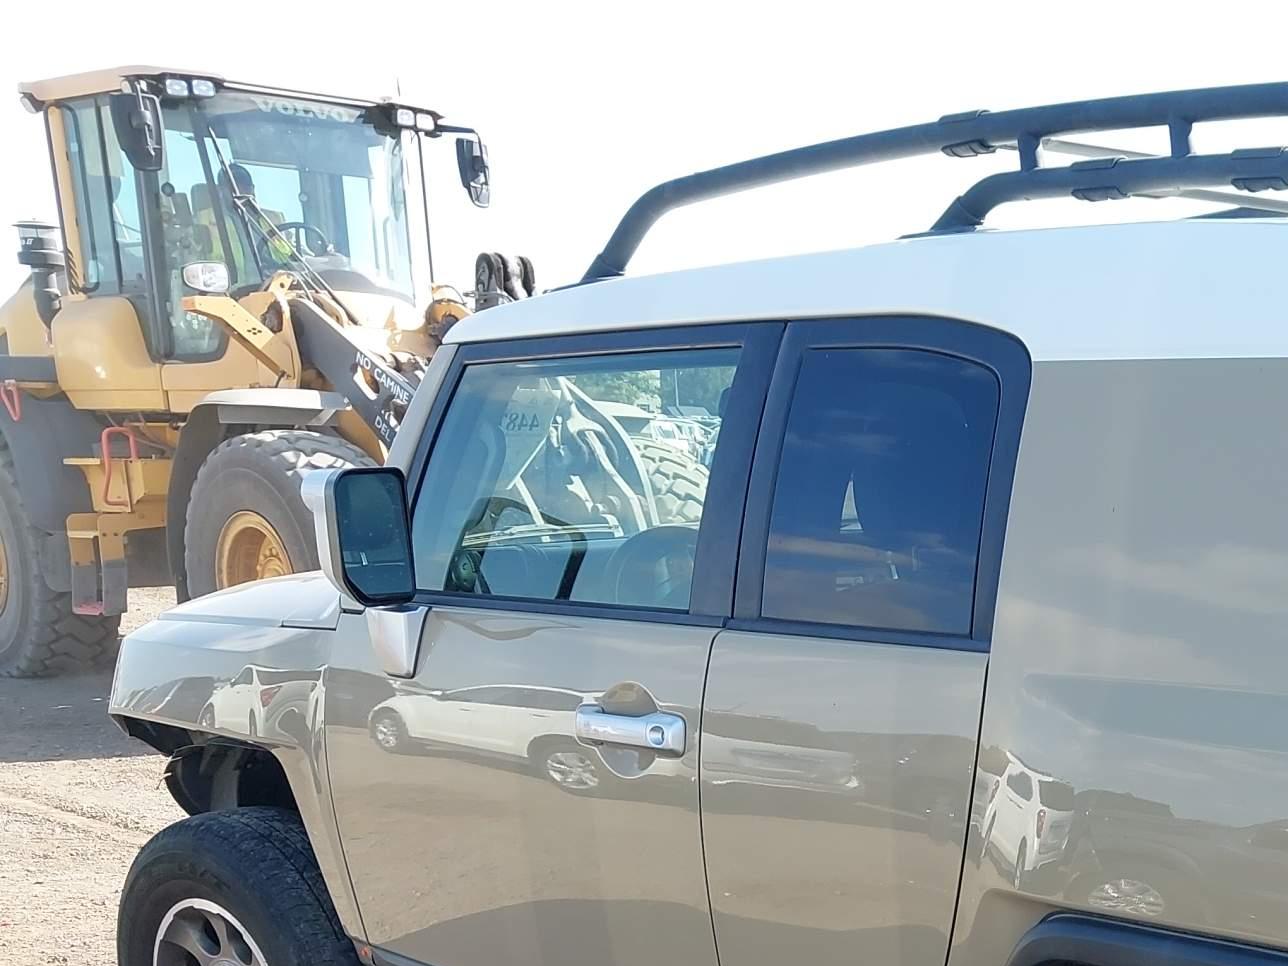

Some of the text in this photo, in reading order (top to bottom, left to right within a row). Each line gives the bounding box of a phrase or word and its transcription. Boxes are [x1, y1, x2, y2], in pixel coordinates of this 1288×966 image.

[255, 98, 357, 123] VOLVO
[356, 351, 410, 403] NO CAMINE
